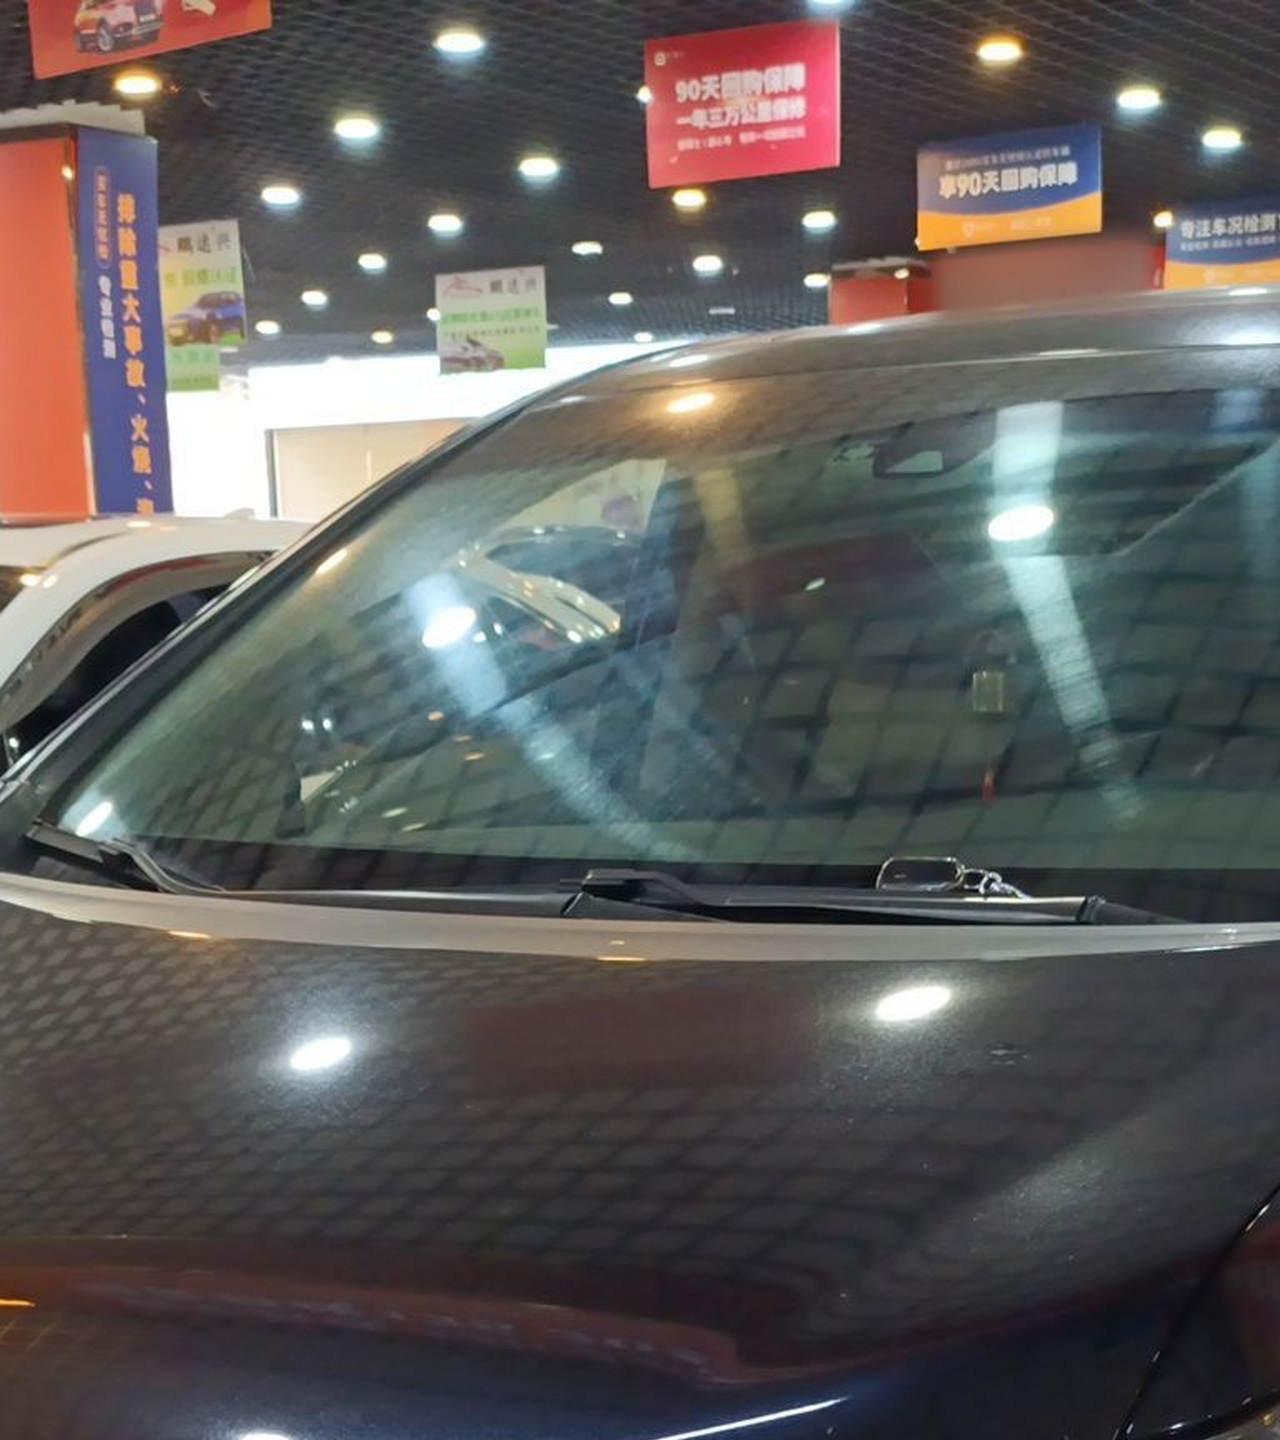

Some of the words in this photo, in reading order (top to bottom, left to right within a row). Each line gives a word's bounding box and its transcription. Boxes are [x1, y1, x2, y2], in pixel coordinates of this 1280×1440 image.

[674, 61, 807, 104] 90天回购保障
[938, 160, 1078, 200] 享90天回购保障
